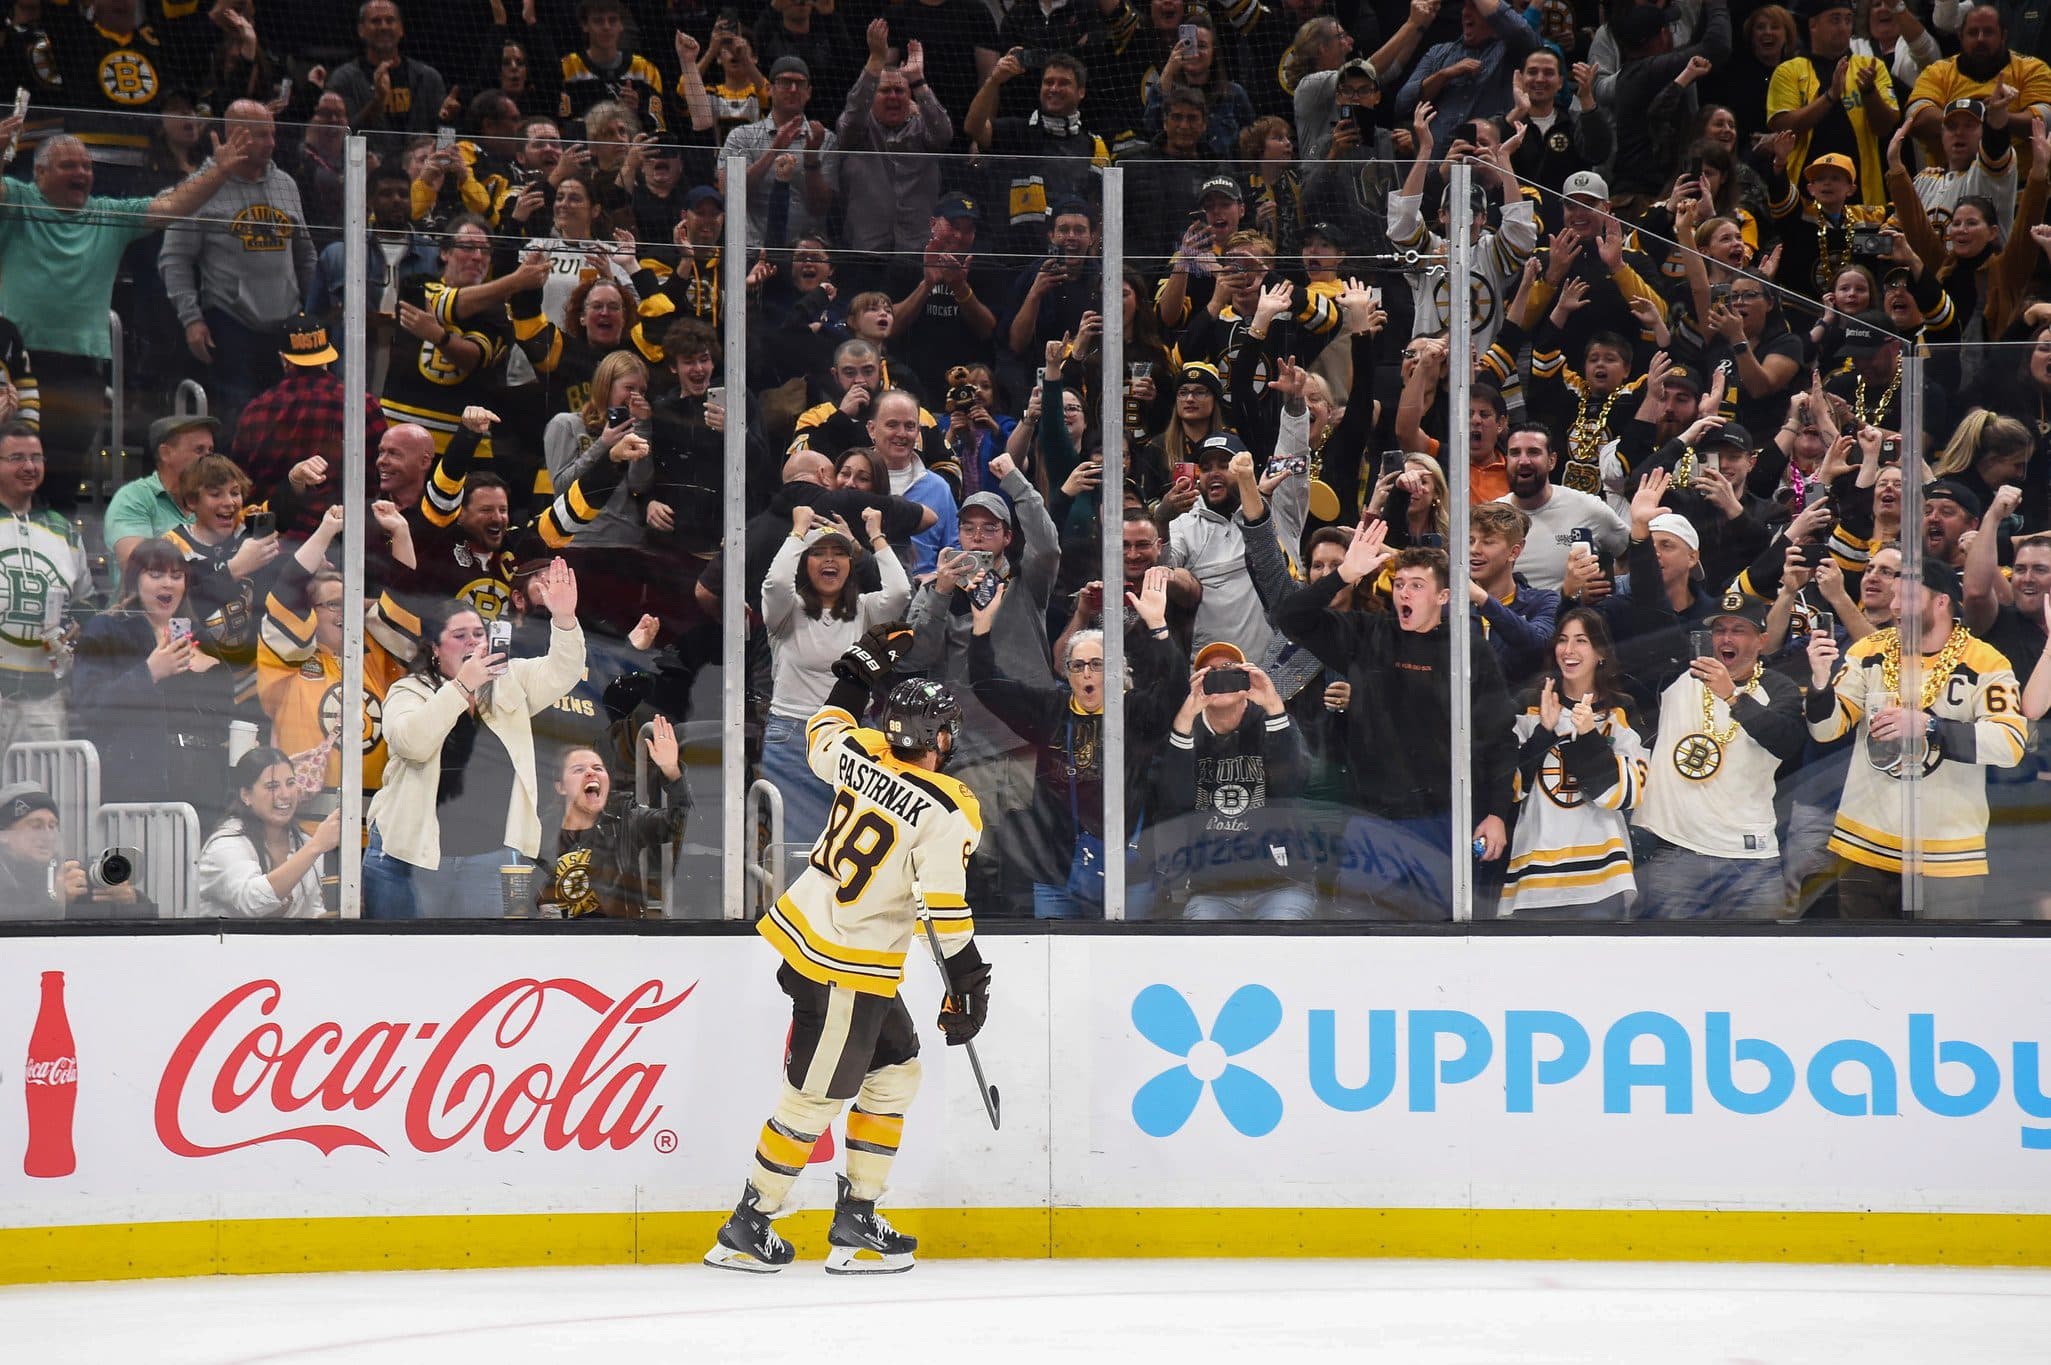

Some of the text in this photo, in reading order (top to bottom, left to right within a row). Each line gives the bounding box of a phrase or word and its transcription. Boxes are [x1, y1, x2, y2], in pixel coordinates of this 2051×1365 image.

[114, 62, 144, 93] B
[926, 303, 958, 316] HOCKEY
[6, 567, 49, 623] B
[1946, 677, 1965, 706] C
[889, 719, 902, 732] 88
[1687, 744, 1710, 770] B
[839, 753, 922, 828] PASTRNAK
[1223, 789, 1240, 808] B
[810, 786, 899, 907] 88
[154, 978, 699, 1157] Coca-Cola
